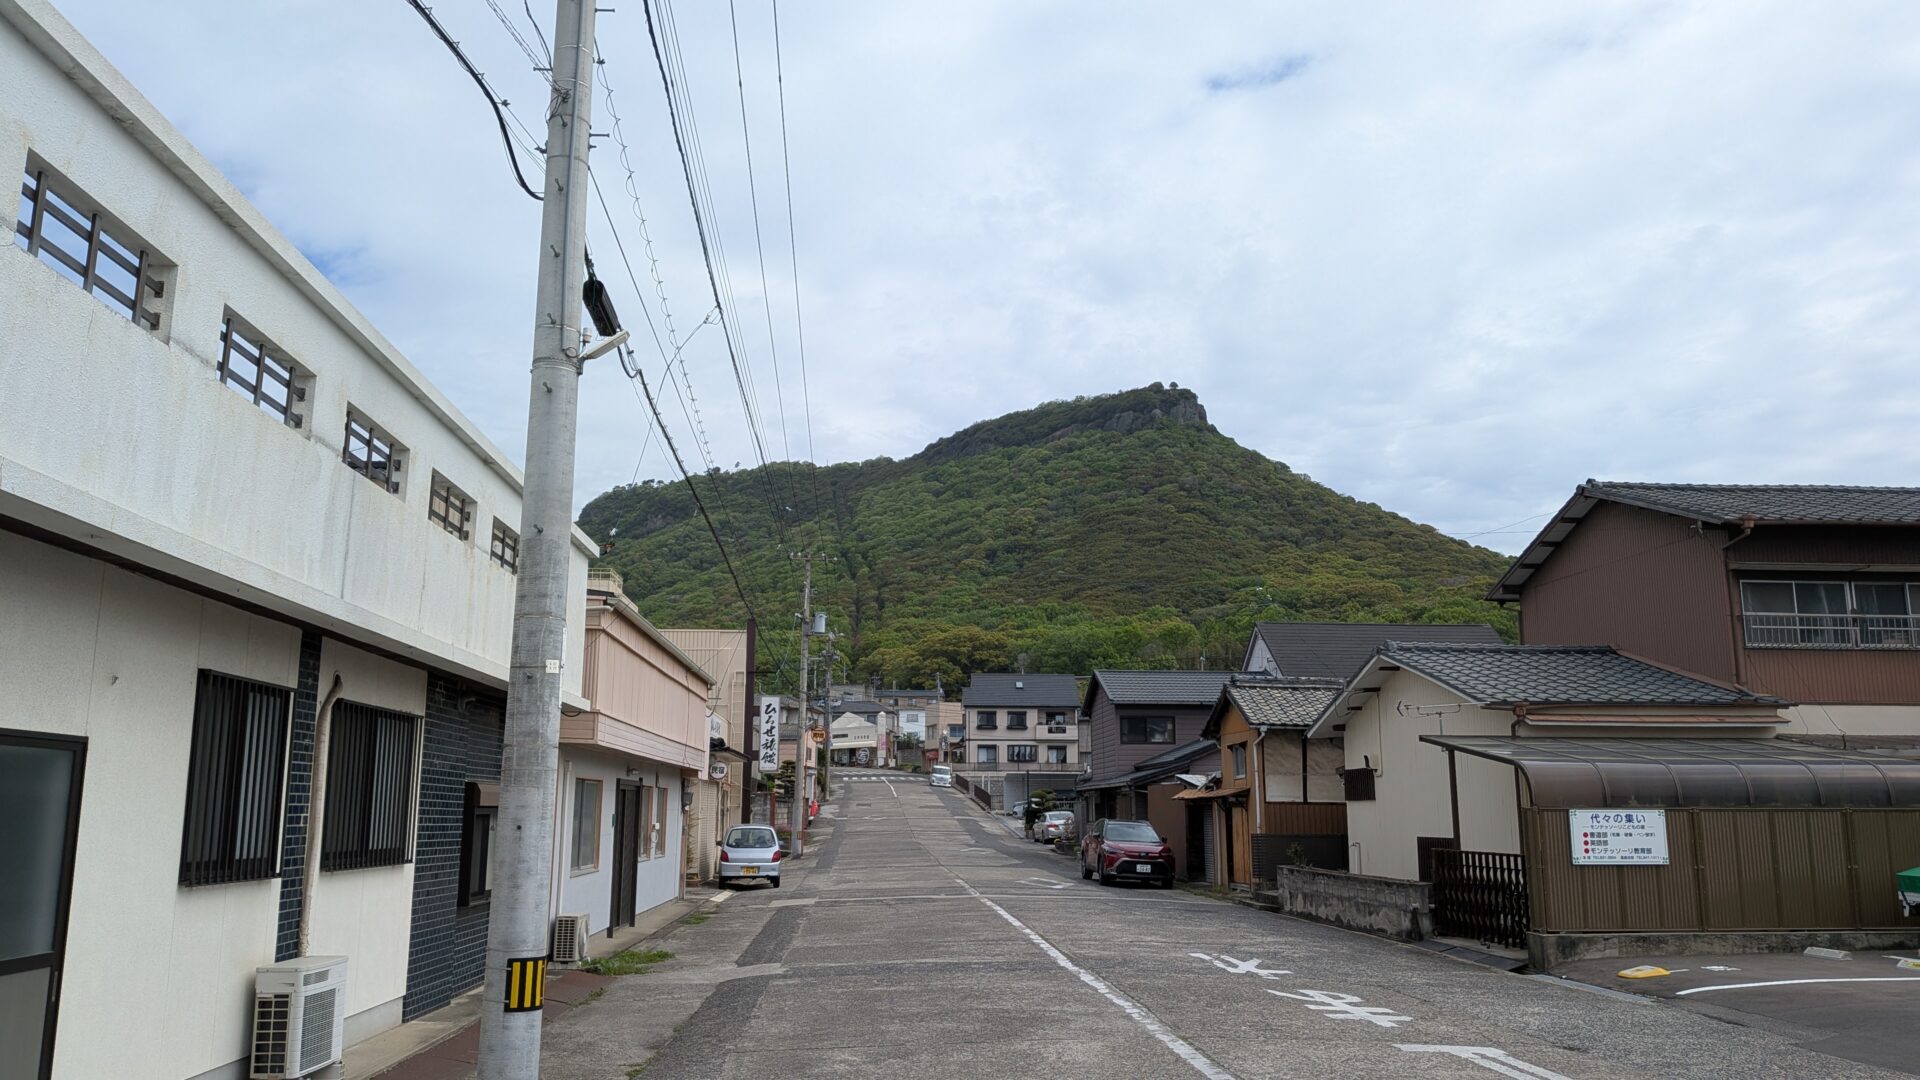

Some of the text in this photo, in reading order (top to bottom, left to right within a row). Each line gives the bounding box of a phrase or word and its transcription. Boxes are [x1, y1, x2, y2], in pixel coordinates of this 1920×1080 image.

[711, 765, 725, 775] 民宿
[1590, 813, 1646, 824] 代々の集い
